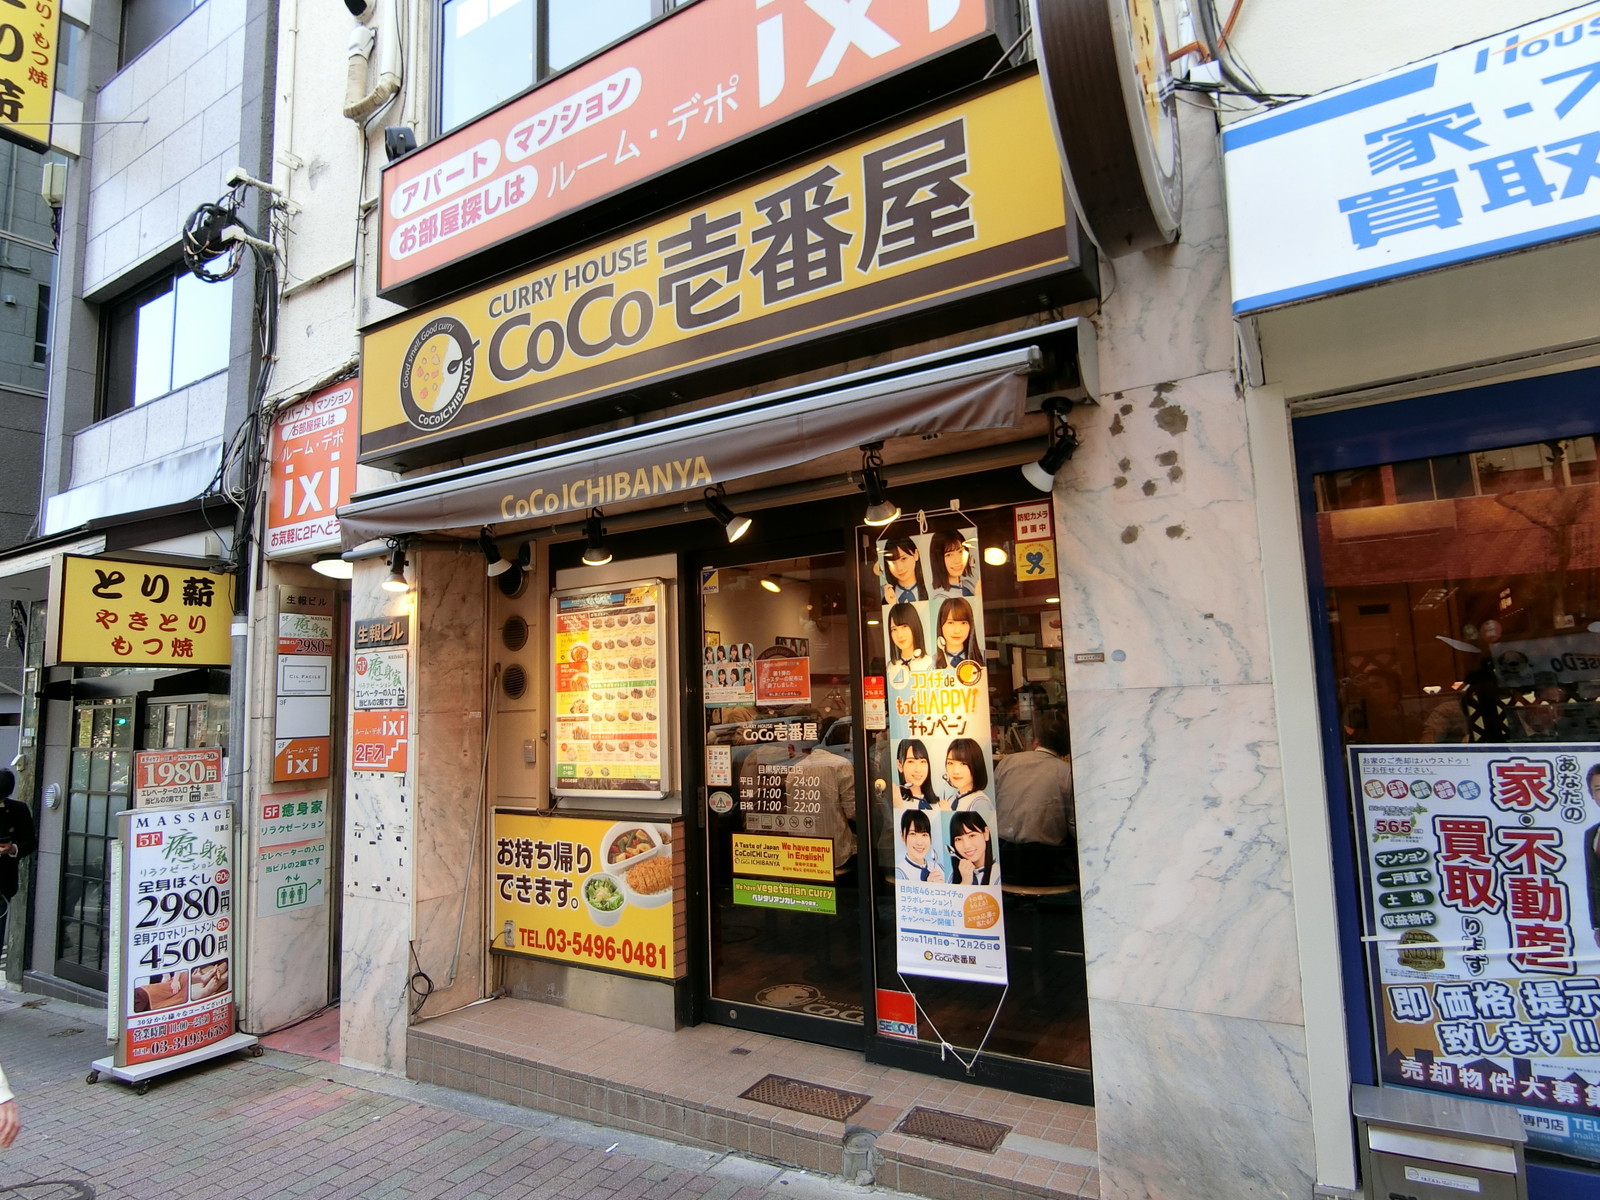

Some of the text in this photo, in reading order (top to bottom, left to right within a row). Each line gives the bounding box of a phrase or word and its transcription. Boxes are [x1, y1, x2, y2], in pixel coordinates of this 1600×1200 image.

[514, 78, 630, 152] マンション
[548, 74, 739, 197] ルーム・デポ
[402, 152, 488, 212] アパート
[1338, 131, 1600, 250] 買取
[399, 174, 525, 253] お部屋探しは
[489, 240, 647, 318] CURRY HOUSE
[316, 393, 351, 410] マンション
[291, 414, 335, 436] お部屋探しは
[282, 428, 345, 462] ルーム・デポ
[283, 451, 340, 519] ixi
[1017, 510, 1048, 521] 防犯カメラ
[92, 569, 215, 607] とり薪
[286, 595, 327, 606] 生報ビル
[96, 609, 206, 634] やきとり
[357, 622, 405, 644] 生報ビル
[111, 635, 193, 658] もつ焼
[296, 639, 325, 653] 2980
[356, 661, 367, 671] 5F
[356, 689, 397, 697] エレベーターの入口
[382, 715, 404, 736] ixi
[909, 715, 967, 736] キャンペーン
[287, 753, 318, 775] ixi
[740, 776, 820, 787] 平日 11:00 24:00
[1559, 756, 1583, 820] あなたの
[141, 787, 187, 796] エレベーターの入口
[757, 788, 781, 799] 11:00
[793, 789, 820, 800] 23:00
[265, 807, 278, 817] 5F
[282, 800, 323, 817] 癒身家
[757, 800, 781, 811] 11:00
[793, 802, 820, 813] 22:00
[136, 809, 230, 828] MASSAGE
[1376, 820, 1412, 834] 565
[261, 820, 325, 835] リラクゼーション
[139, 832, 161, 847] 5F
[782, 842, 790, 850] We
[793, 843, 809, 851] have
[261, 844, 325, 860] エレベーターの入口
[497, 838, 592, 873] お持ち帰り
[796, 853, 824, 861] English!
[1376, 851, 1428, 866] マンション
[140, 861, 215, 877] リラクゼーション
[266, 858, 320, 873] 当ビルの2階です
[138, 873, 211, 894] 全身ほぐし
[1379, 872, 1430, 885] 一戸建て
[497, 873, 579, 909] できます。
[757, 884, 806, 896] vegetarian
[809, 889, 832, 899] curry
[900, 886, 964, 898] 日向坂46とココイチの
[1383, 913, 1434, 927] 収益物件
[134, 921, 216, 946] 全身アロマトリートメント
[880, 1020, 914, 1035] SECOM
[1519, 1114, 1564, 1132] 専門店
